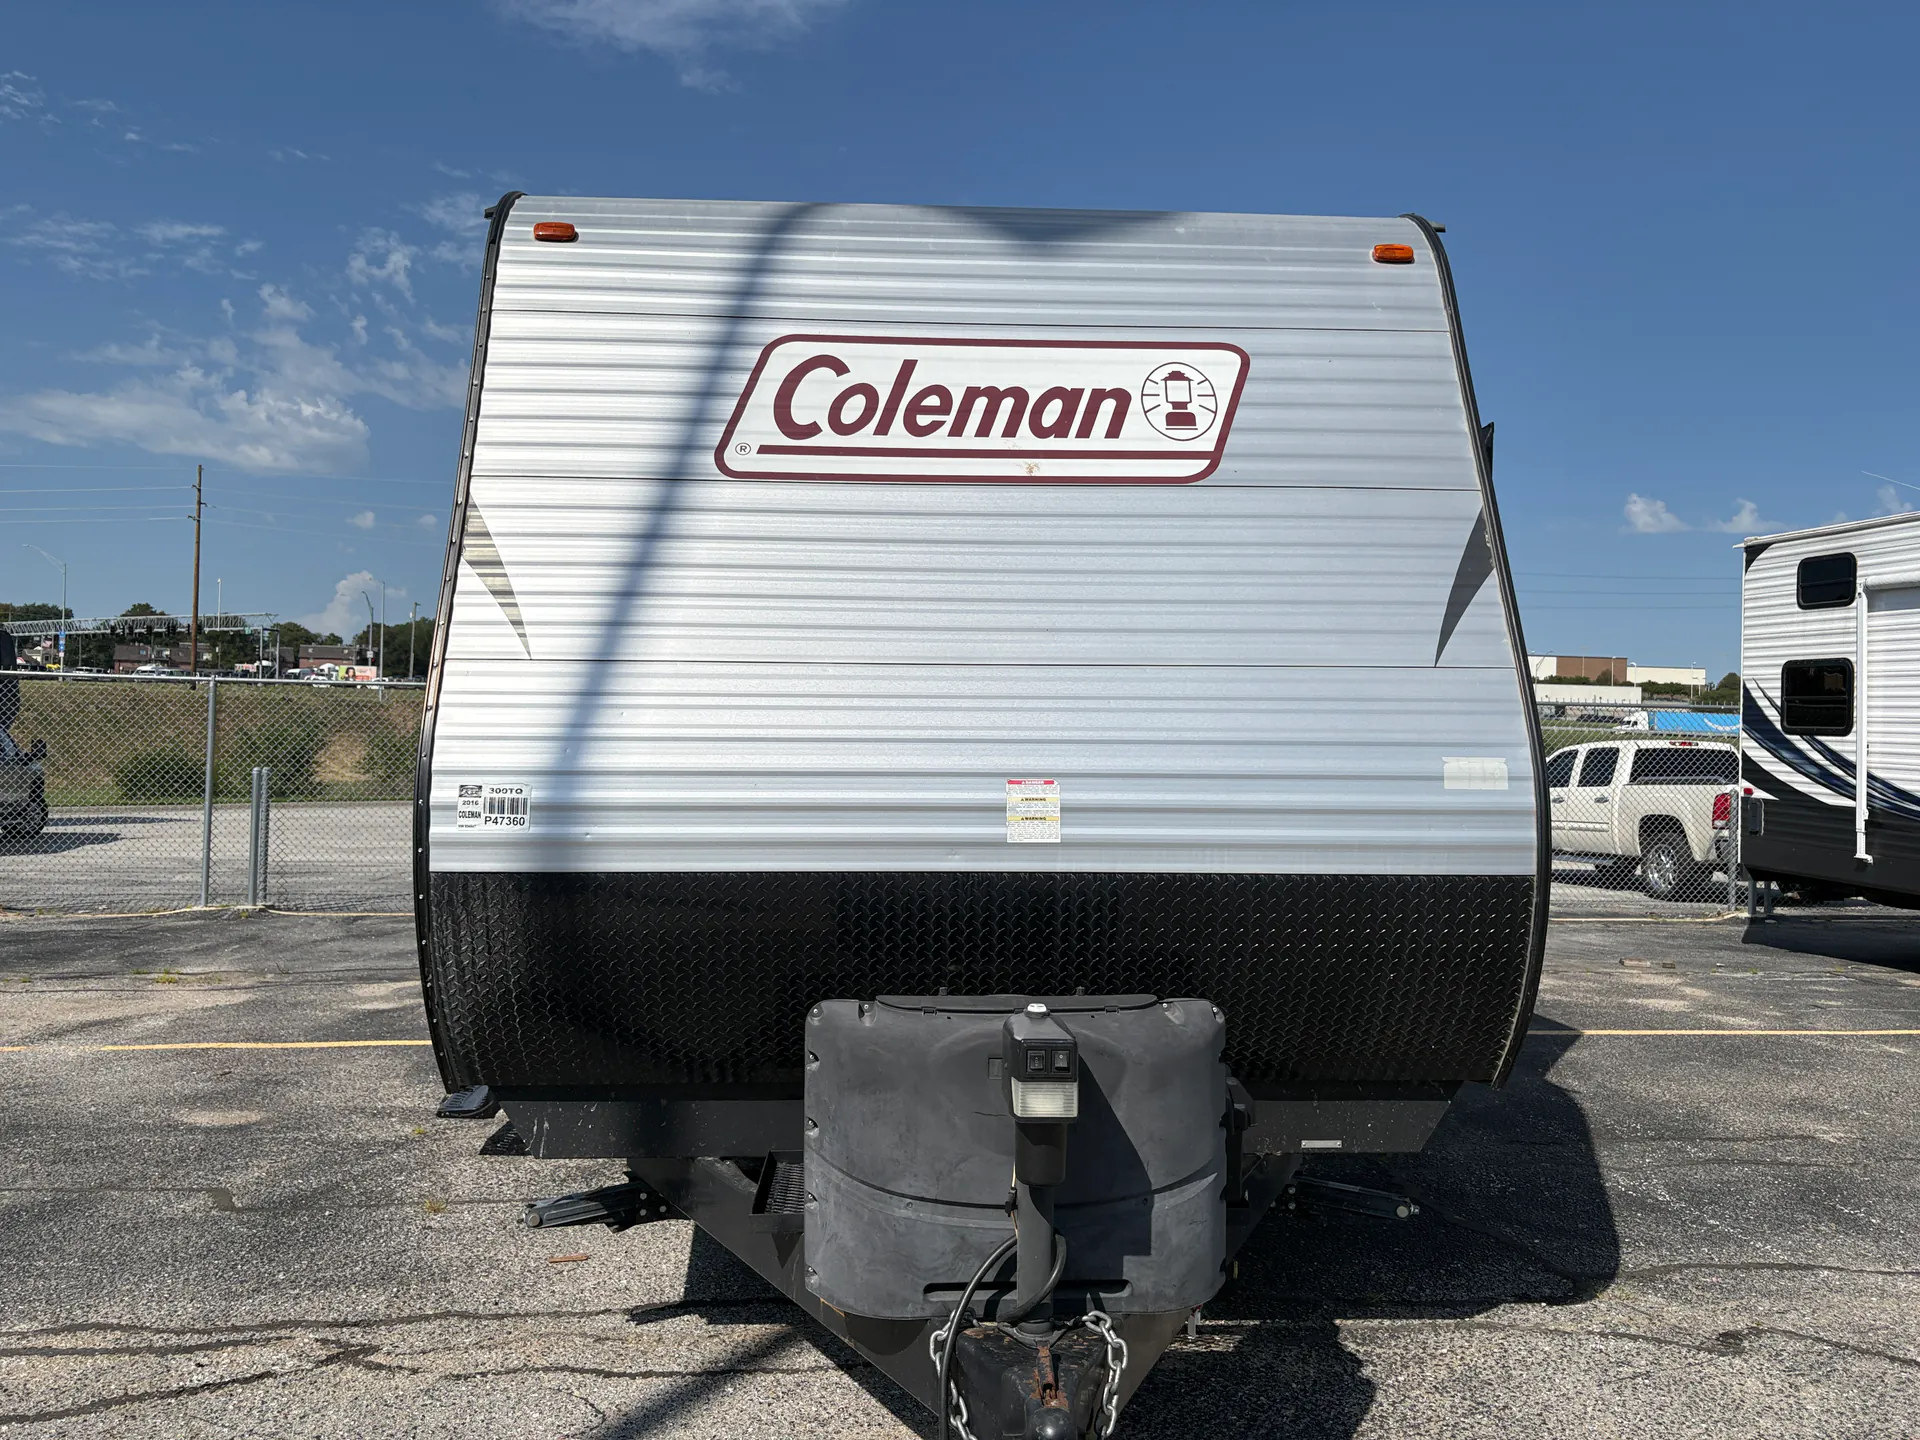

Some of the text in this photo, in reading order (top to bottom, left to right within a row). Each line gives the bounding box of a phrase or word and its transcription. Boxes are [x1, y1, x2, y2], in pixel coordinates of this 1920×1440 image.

[773, 354, 1132, 440] Coleman
[458, 810, 482, 819] COLEMAN
[484, 816, 525, 826] P47360
